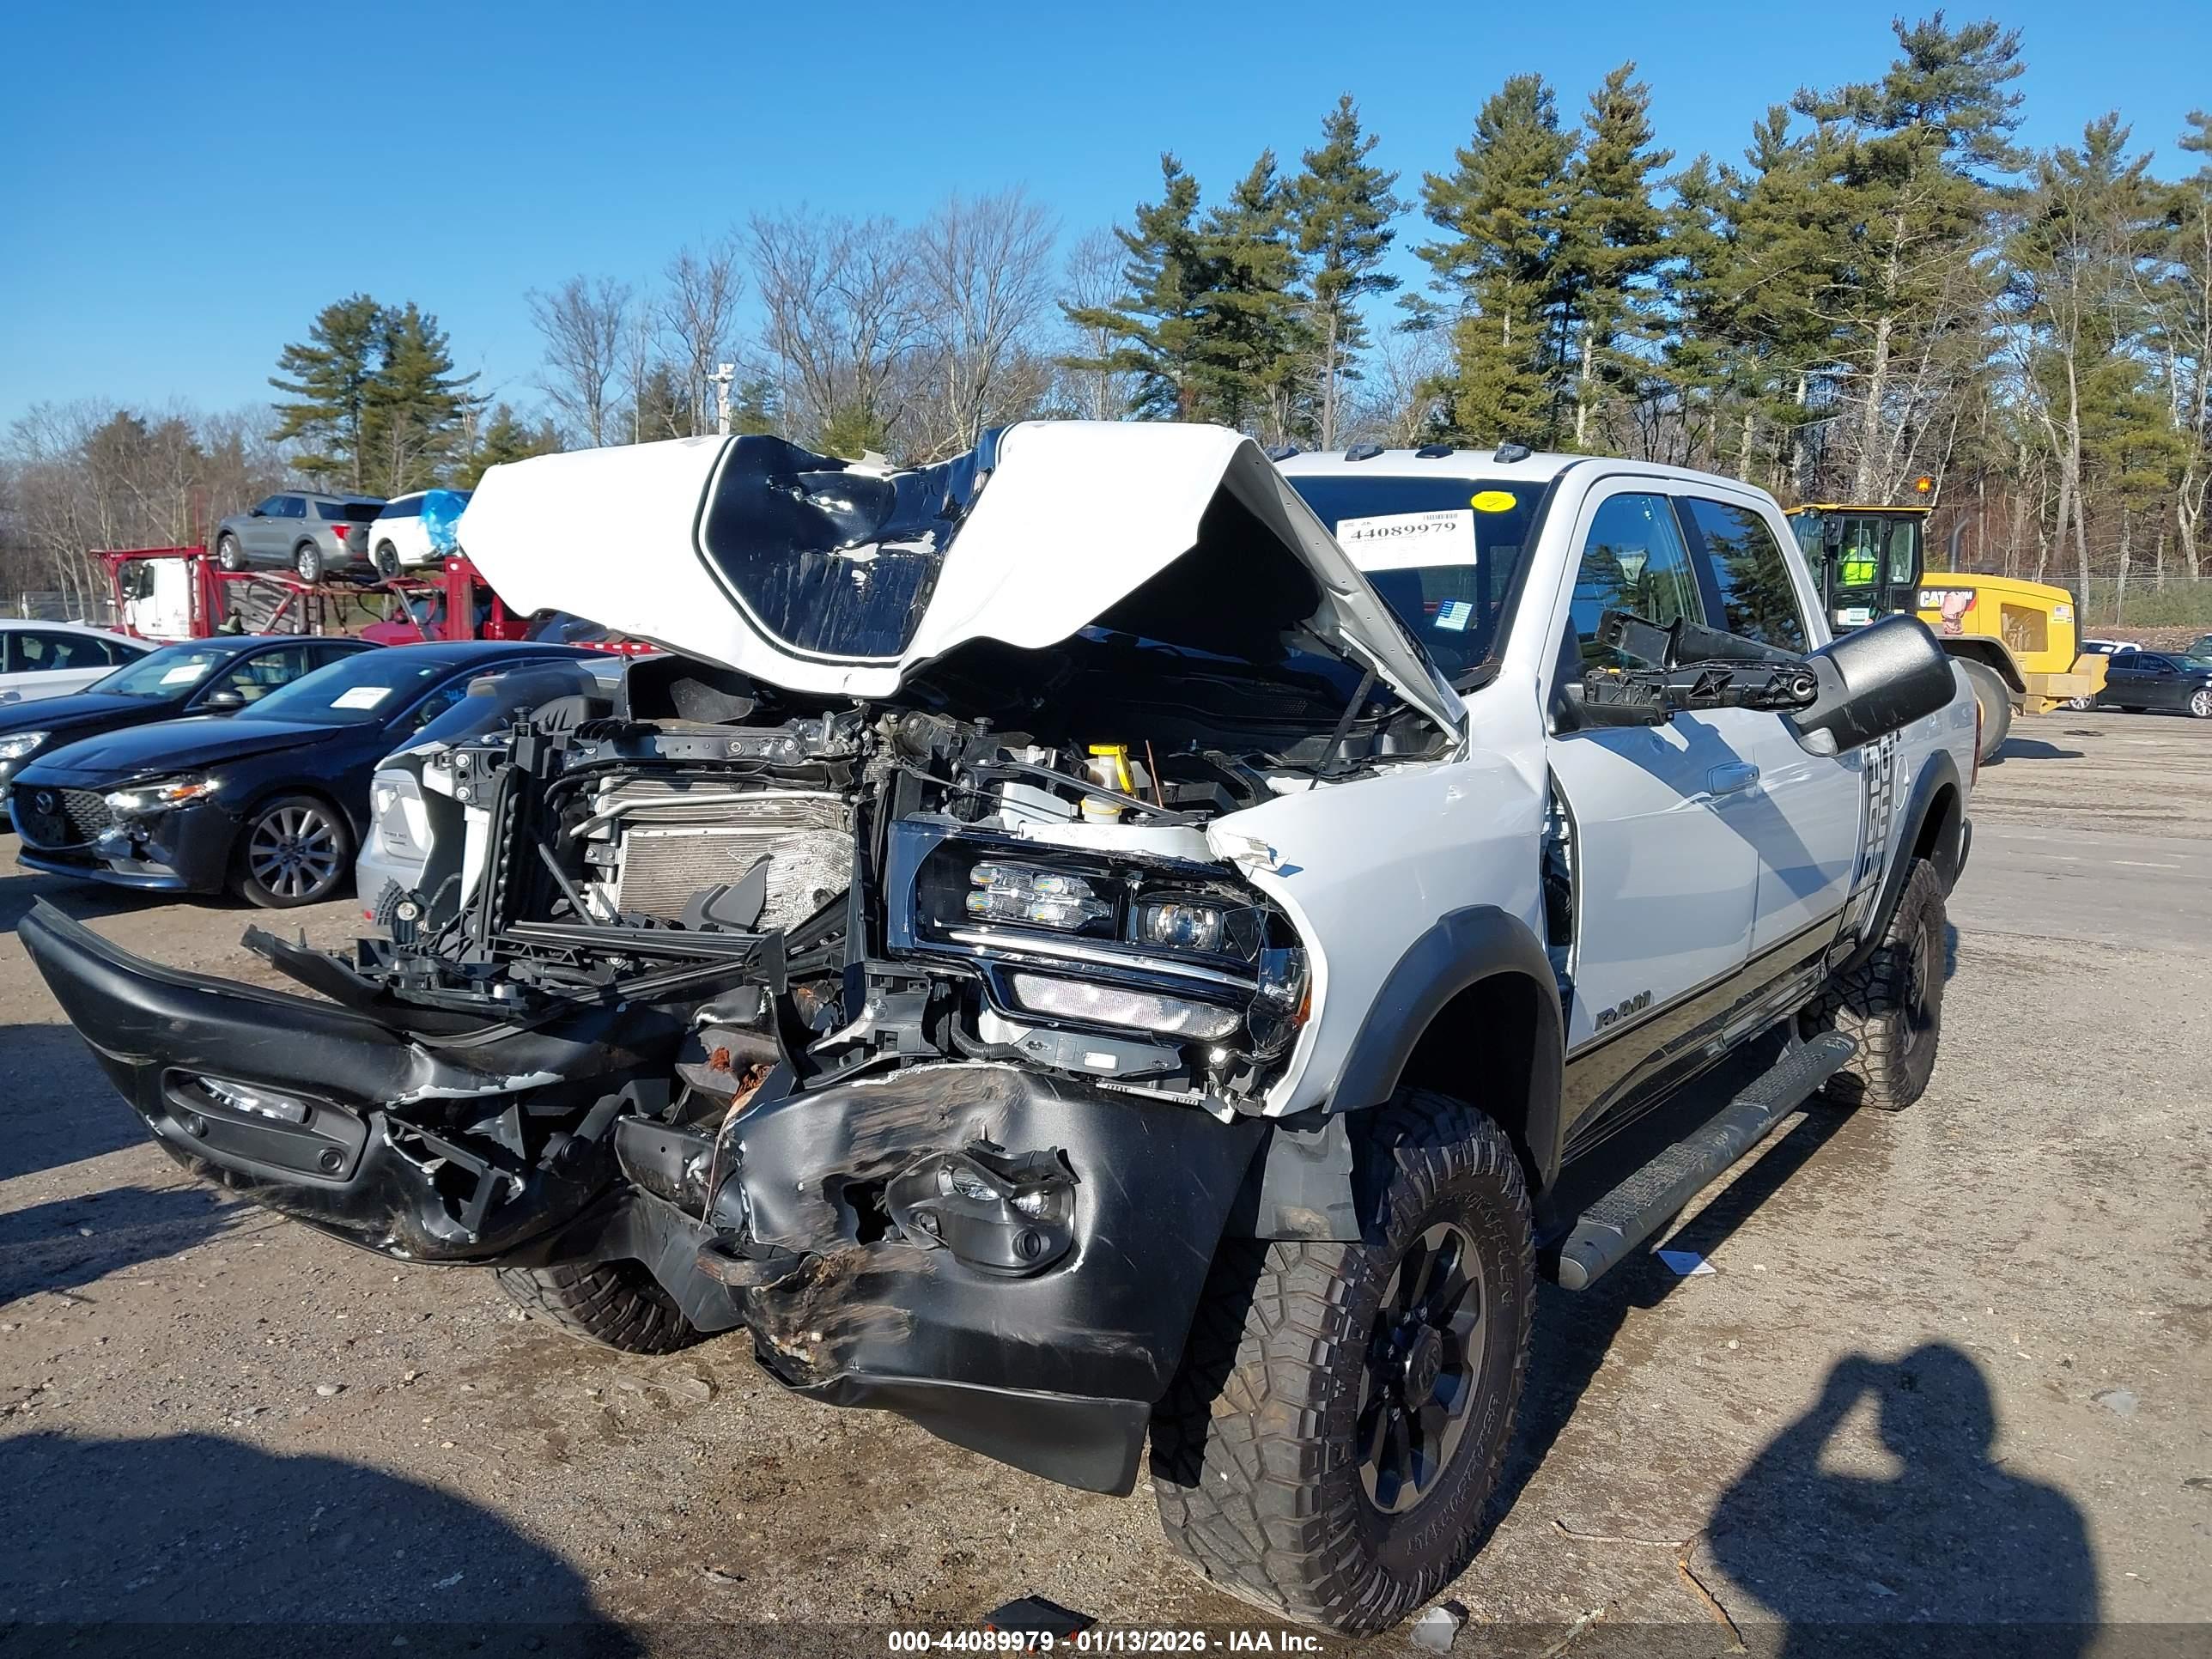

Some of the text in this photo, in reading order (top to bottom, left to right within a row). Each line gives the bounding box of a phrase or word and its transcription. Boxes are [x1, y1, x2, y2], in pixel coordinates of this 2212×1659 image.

[1350, 521, 1457, 540] 44089979
[1919, 590, 1948, 608] CAT
[1593, 989, 1652, 1032] RAM
